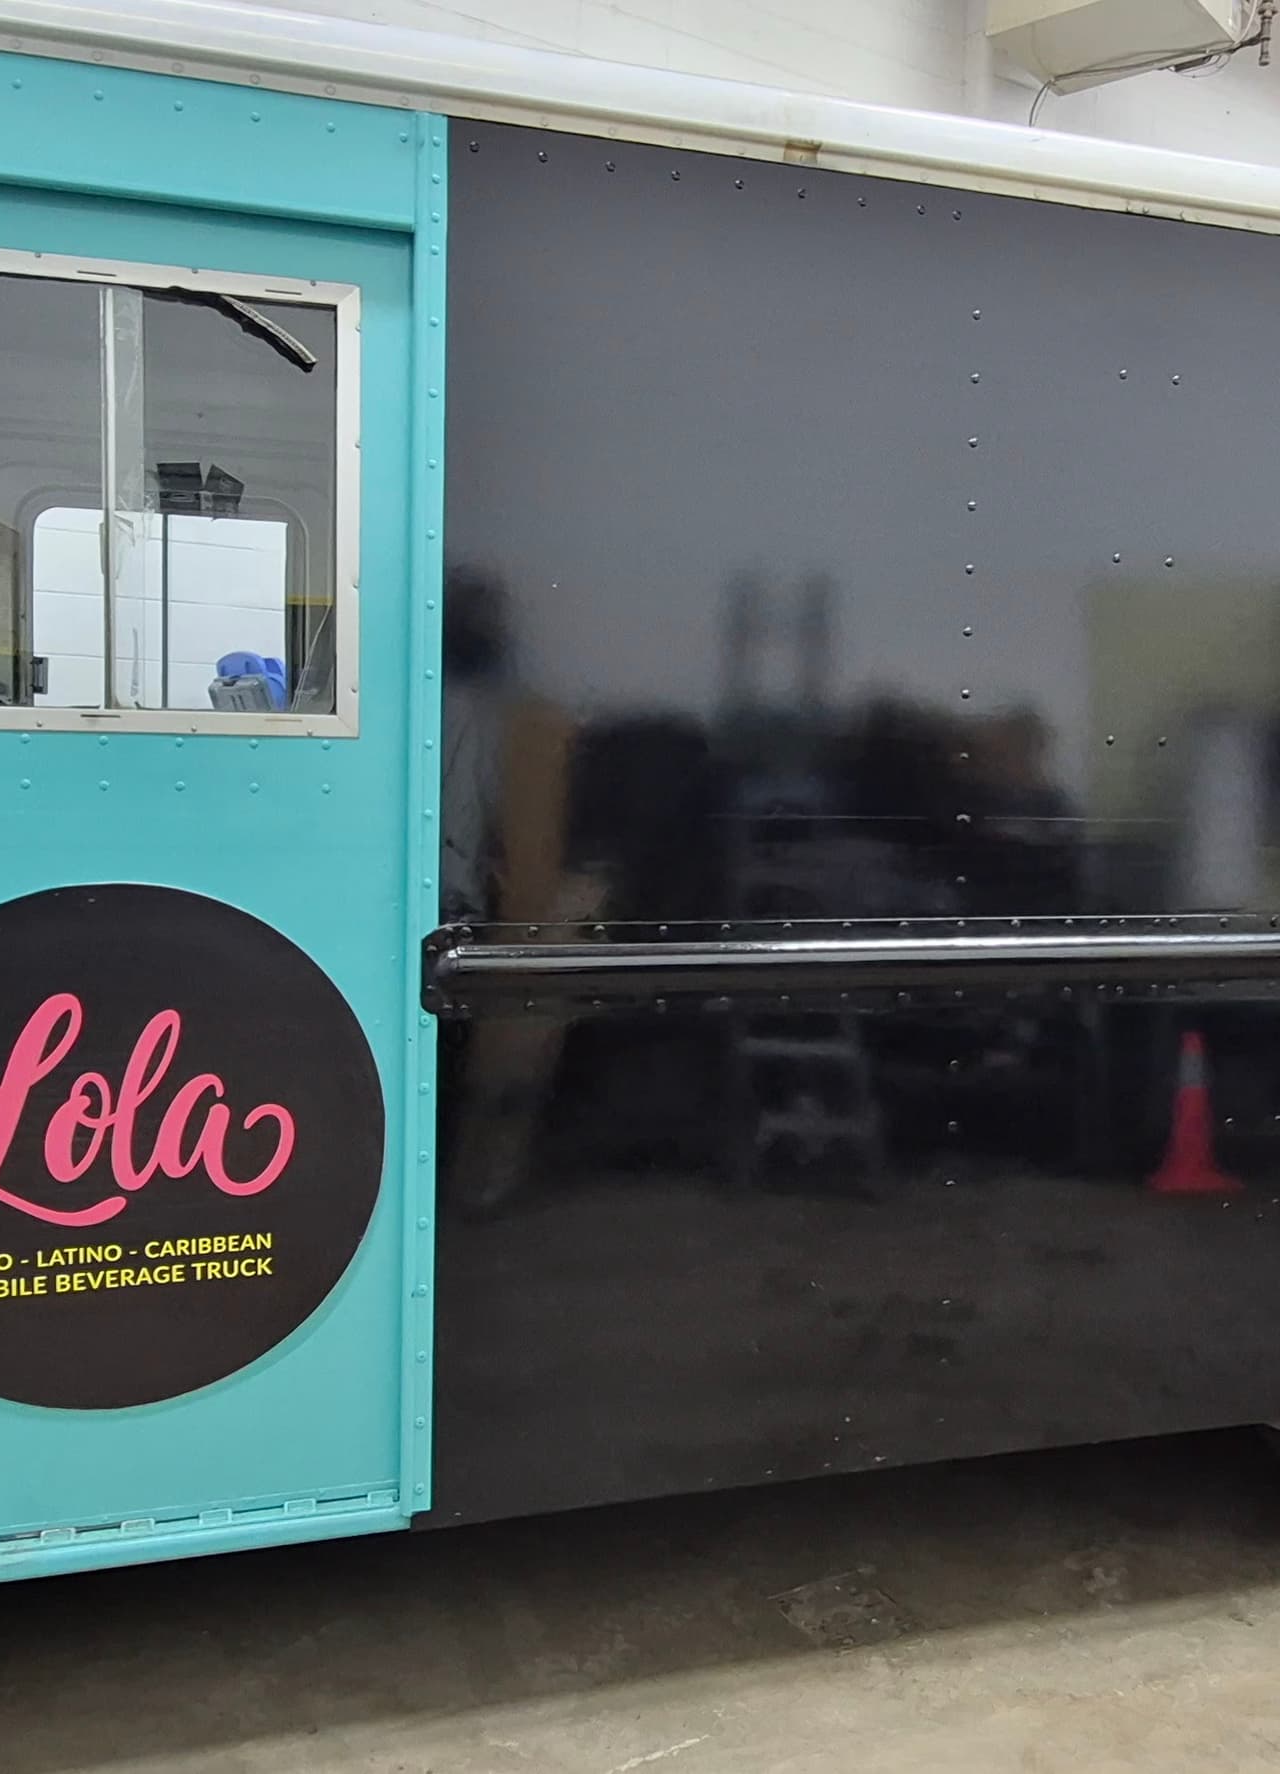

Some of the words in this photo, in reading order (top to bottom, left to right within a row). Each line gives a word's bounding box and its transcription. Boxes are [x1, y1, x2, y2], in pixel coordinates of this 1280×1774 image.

[37, 1244, 122, 1268] LATINO
[145, 1232, 272, 1259] CARIBBEAN
[55, 1264, 185, 1293] BEVERAGE
[191, 1257, 273, 1281] TRUCK
